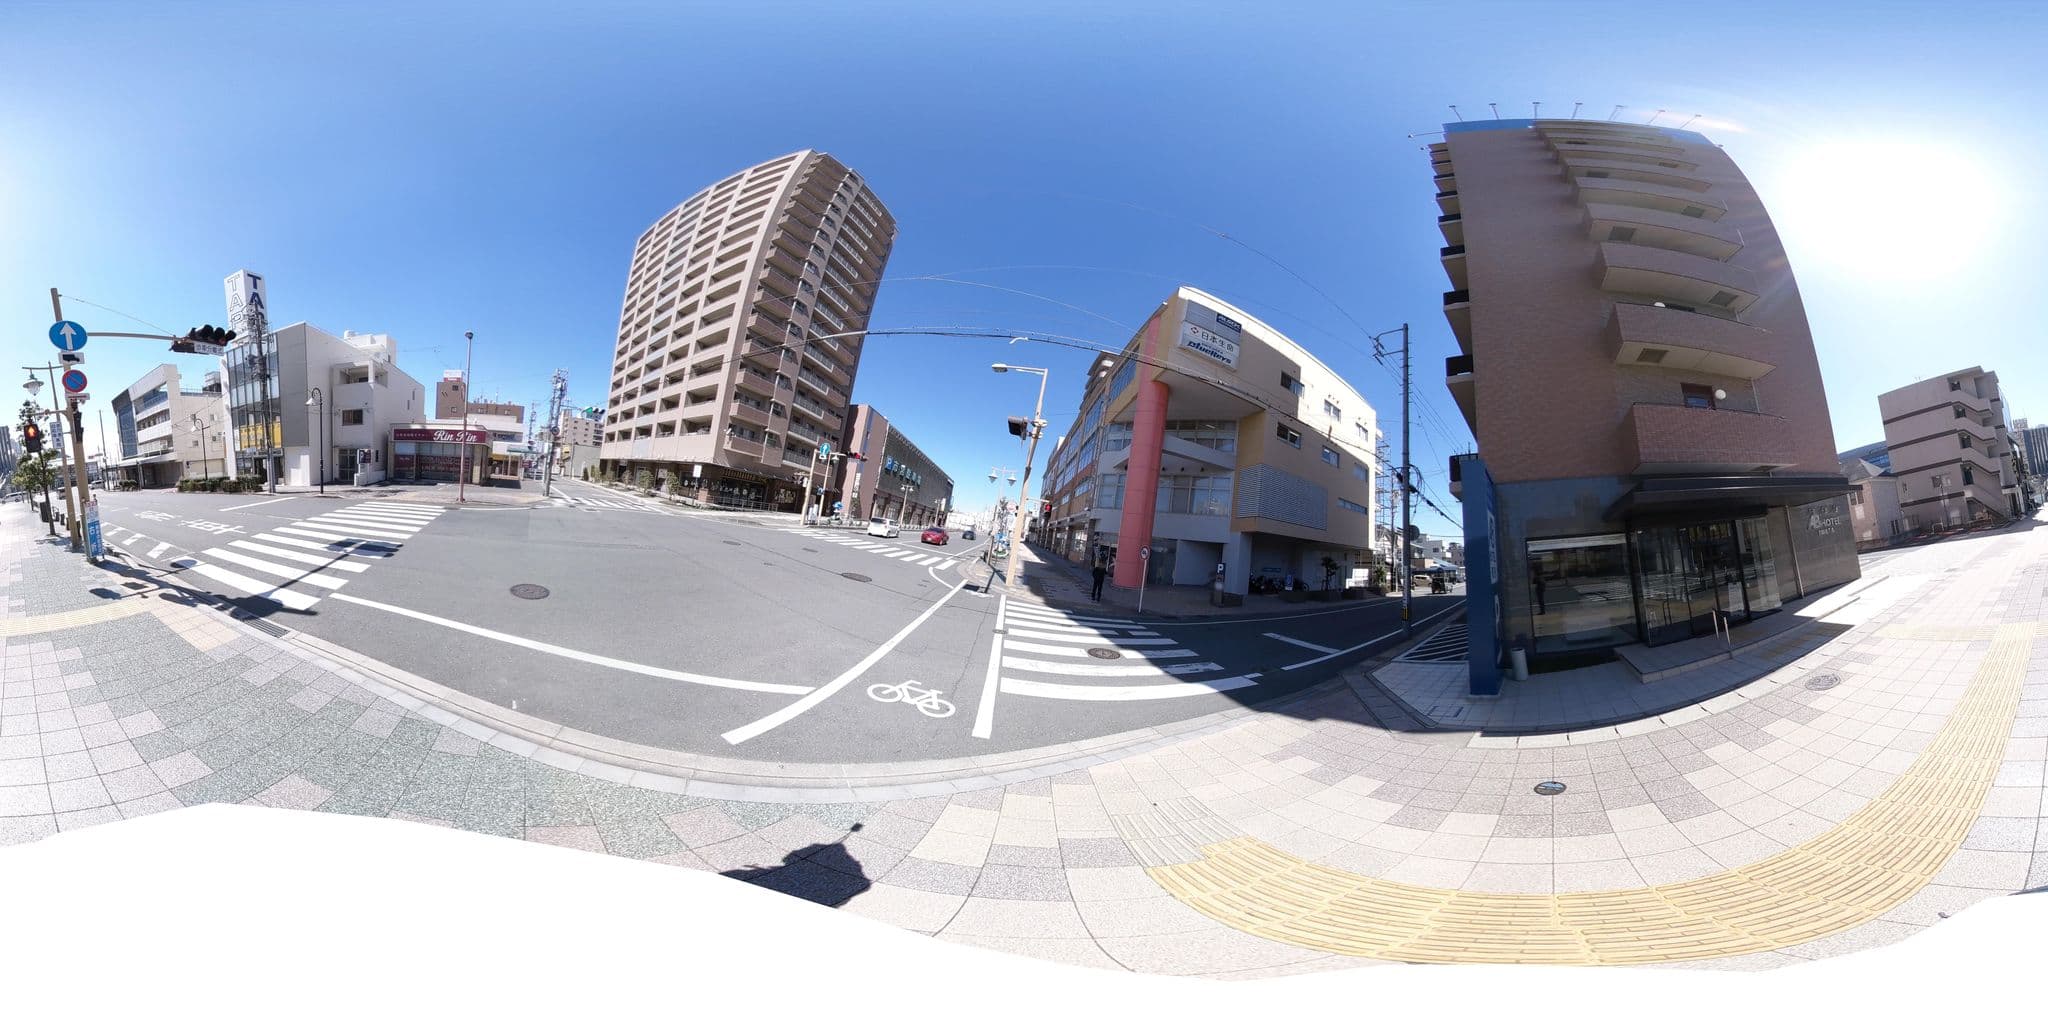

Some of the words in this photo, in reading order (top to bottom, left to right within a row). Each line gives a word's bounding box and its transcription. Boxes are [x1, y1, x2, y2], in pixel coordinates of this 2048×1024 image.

[1201, 331, 1234, 353] 日本生命
[433, 430, 453, 441] Rin
[1821, 516, 1841, 527] HOTEL
[1217, 563, 1224, 573] P
